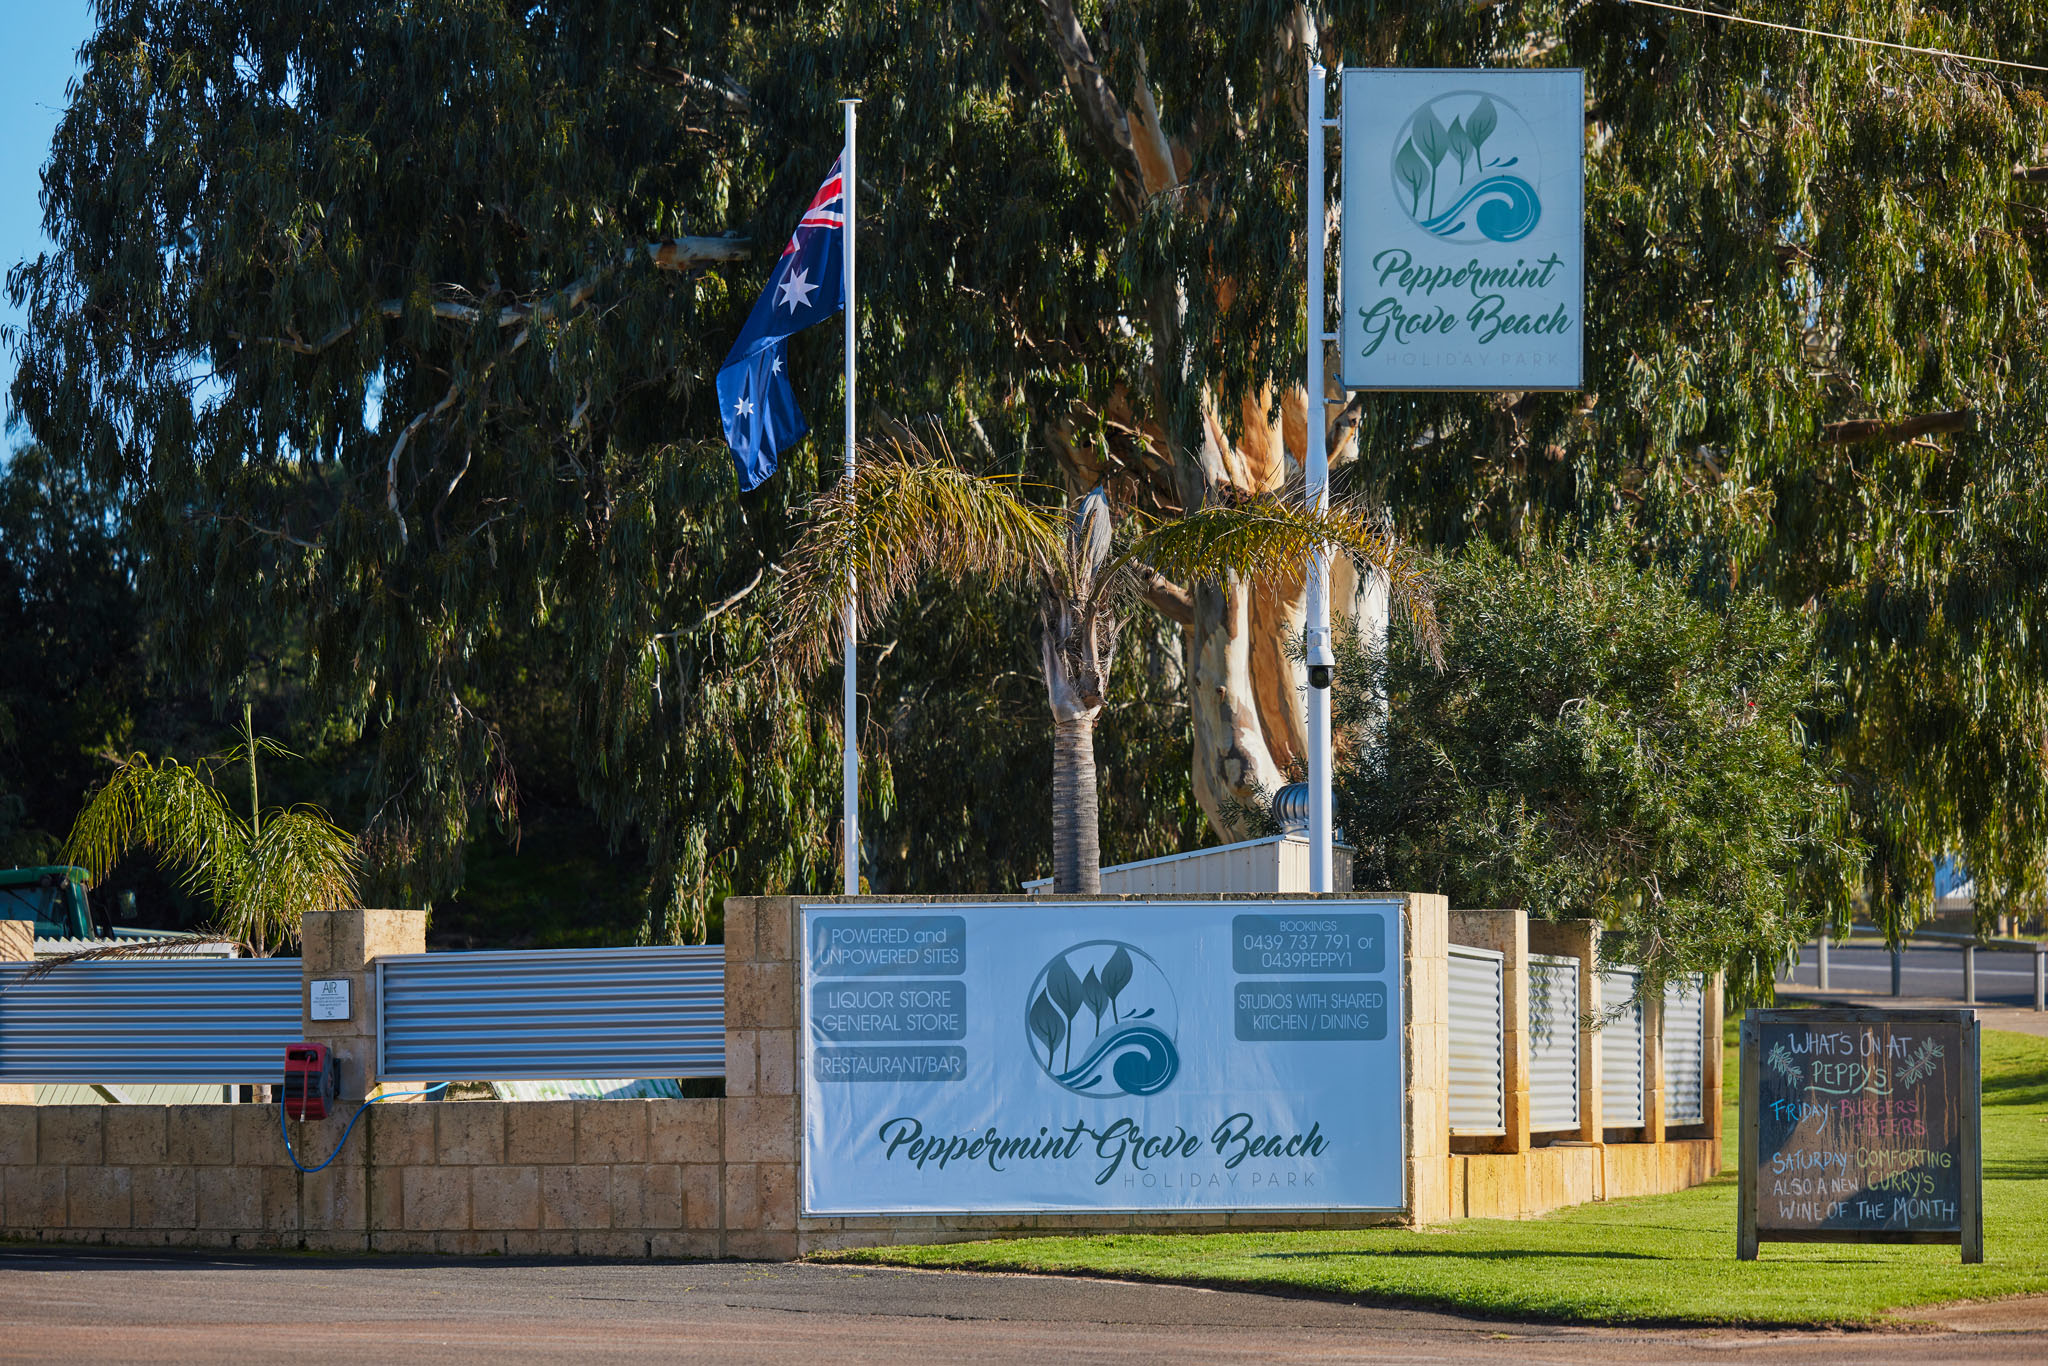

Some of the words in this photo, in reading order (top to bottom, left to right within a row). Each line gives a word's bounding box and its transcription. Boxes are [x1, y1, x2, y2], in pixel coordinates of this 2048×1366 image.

[1372, 248, 1565, 298] Peppermint
[1358, 297, 1459, 357] Grove
[1466, 294, 1574, 345] Beach
[1386, 352, 1490, 367] HOLIDAY
[1502, 352, 1558, 366] PARK
[1279, 920, 1337, 932] BOOKINGS
[831, 928, 909, 944] POWERED
[913, 927, 947, 944] and
[1243, 935, 1283, 950] 0439
[1289, 934, 1318, 950] 737
[1325, 934, 1351, 950] 791
[1358, 937, 1374, 949] or
[820, 949, 919, 965] UNPOWERED
[923, 948, 959, 964] SITES
[1262, 952, 1352, 968] 0439PEPPY1
[322, 981, 337, 993] AIR
[829, 991, 894, 1009] LIQUOR
[900, 991, 951, 1008] STORE
[1239, 993, 1293, 1010] STUDIOS
[1296, 993, 1327, 1009] WITH
[1331, 993, 1383, 1009] SHARED
[821, 1014, 901, 1031] GENERAL
[906, 1014, 959, 1031] STORE
[1253, 1014, 1307, 1030] KITCHEN
[1321, 1014, 1369, 1030] DINING
[1788, 1031, 1854, 1056] WHAT'S
[1860, 1032, 1881, 1057] ON
[1886, 1035, 1912, 1059] AT
[820, 1056, 961, 1074] RESTAURANT/BAR
[1811, 1060, 1888, 1094] PEPPY'S
[1769, 1098, 1830, 1135] FRIDAY
[1840, 1099, 1919, 1118] BURGERS
[1867, 1117, 1927, 1137] BEERS
[879, 1117, 1091, 1172] Peppermint
[1089, 1117, 1202, 1185] Grove
[1211, 1112, 1330, 1169] Beach
[1772, 1148, 1848, 1176] SATURDAY
[1856, 1146, 1952, 1169] COMFORTING
[1123, 1172, 1240, 1189] HOLIDAY
[1252, 1171, 1315, 1188] PARK
[1773, 1178, 1812, 1196] ALSO
[1817, 1179, 1828, 1195] A
[1832, 1176, 1859, 1193] NEW
[1867, 1169, 1936, 1197] CURRY'S
[1779, 1200, 1823, 1222] WINE
[1827, 1200, 1848, 1219] OF
[1856, 1200, 1885, 1219] THE
[1893, 1197, 1958, 1229] MONTH
